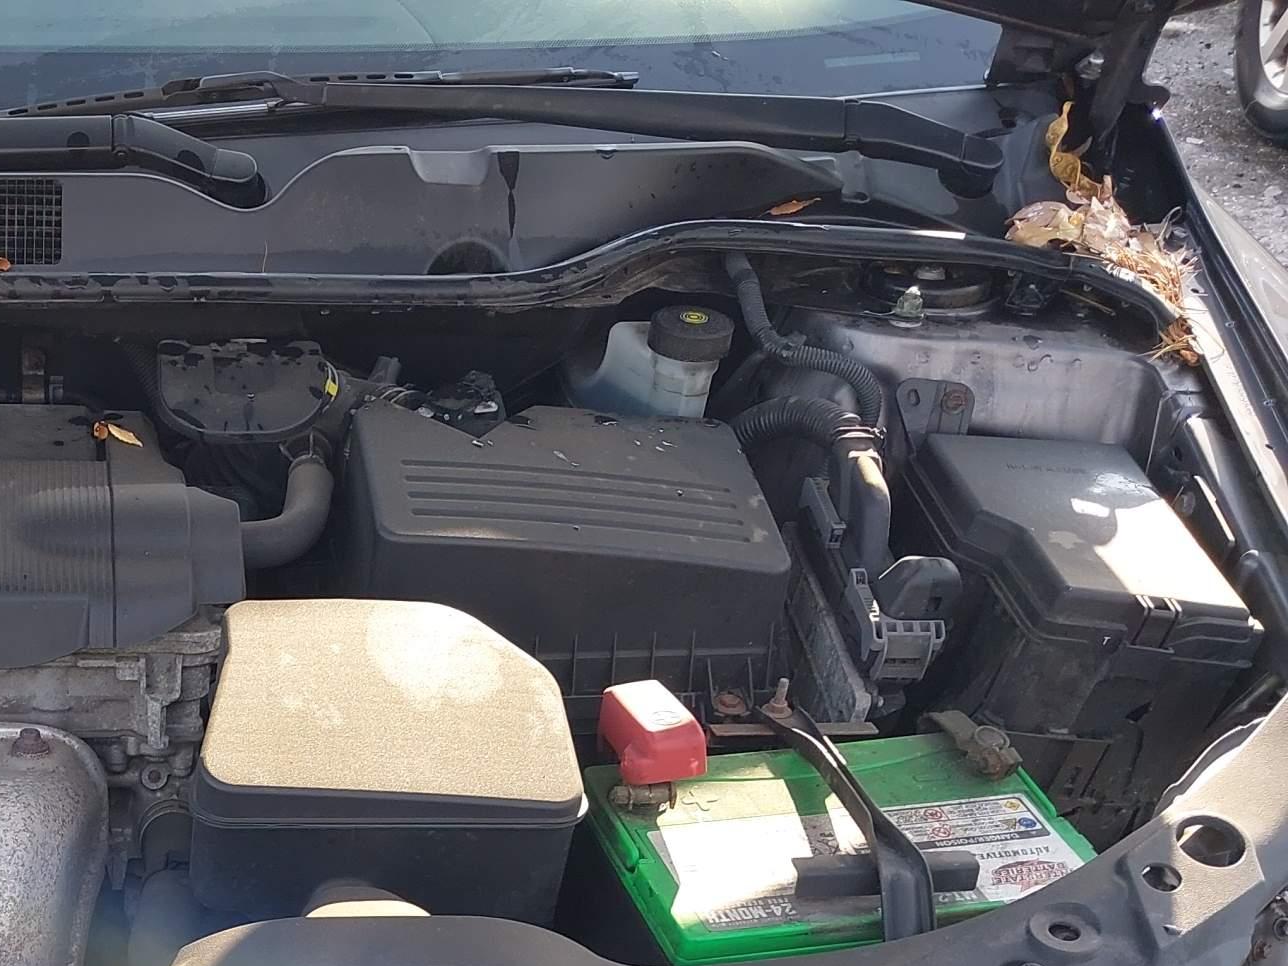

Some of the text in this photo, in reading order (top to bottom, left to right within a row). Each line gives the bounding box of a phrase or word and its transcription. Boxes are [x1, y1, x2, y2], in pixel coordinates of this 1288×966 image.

[935, 832, 1020, 847] DANGER/POISON
[978, 845, 1050, 860] AUTOMOTIVE
[991, 868, 1074, 886] NTERSTATE
[992, 862, 1066, 877] BATTERIES
[704, 902, 797, 924] 24-MONTH
